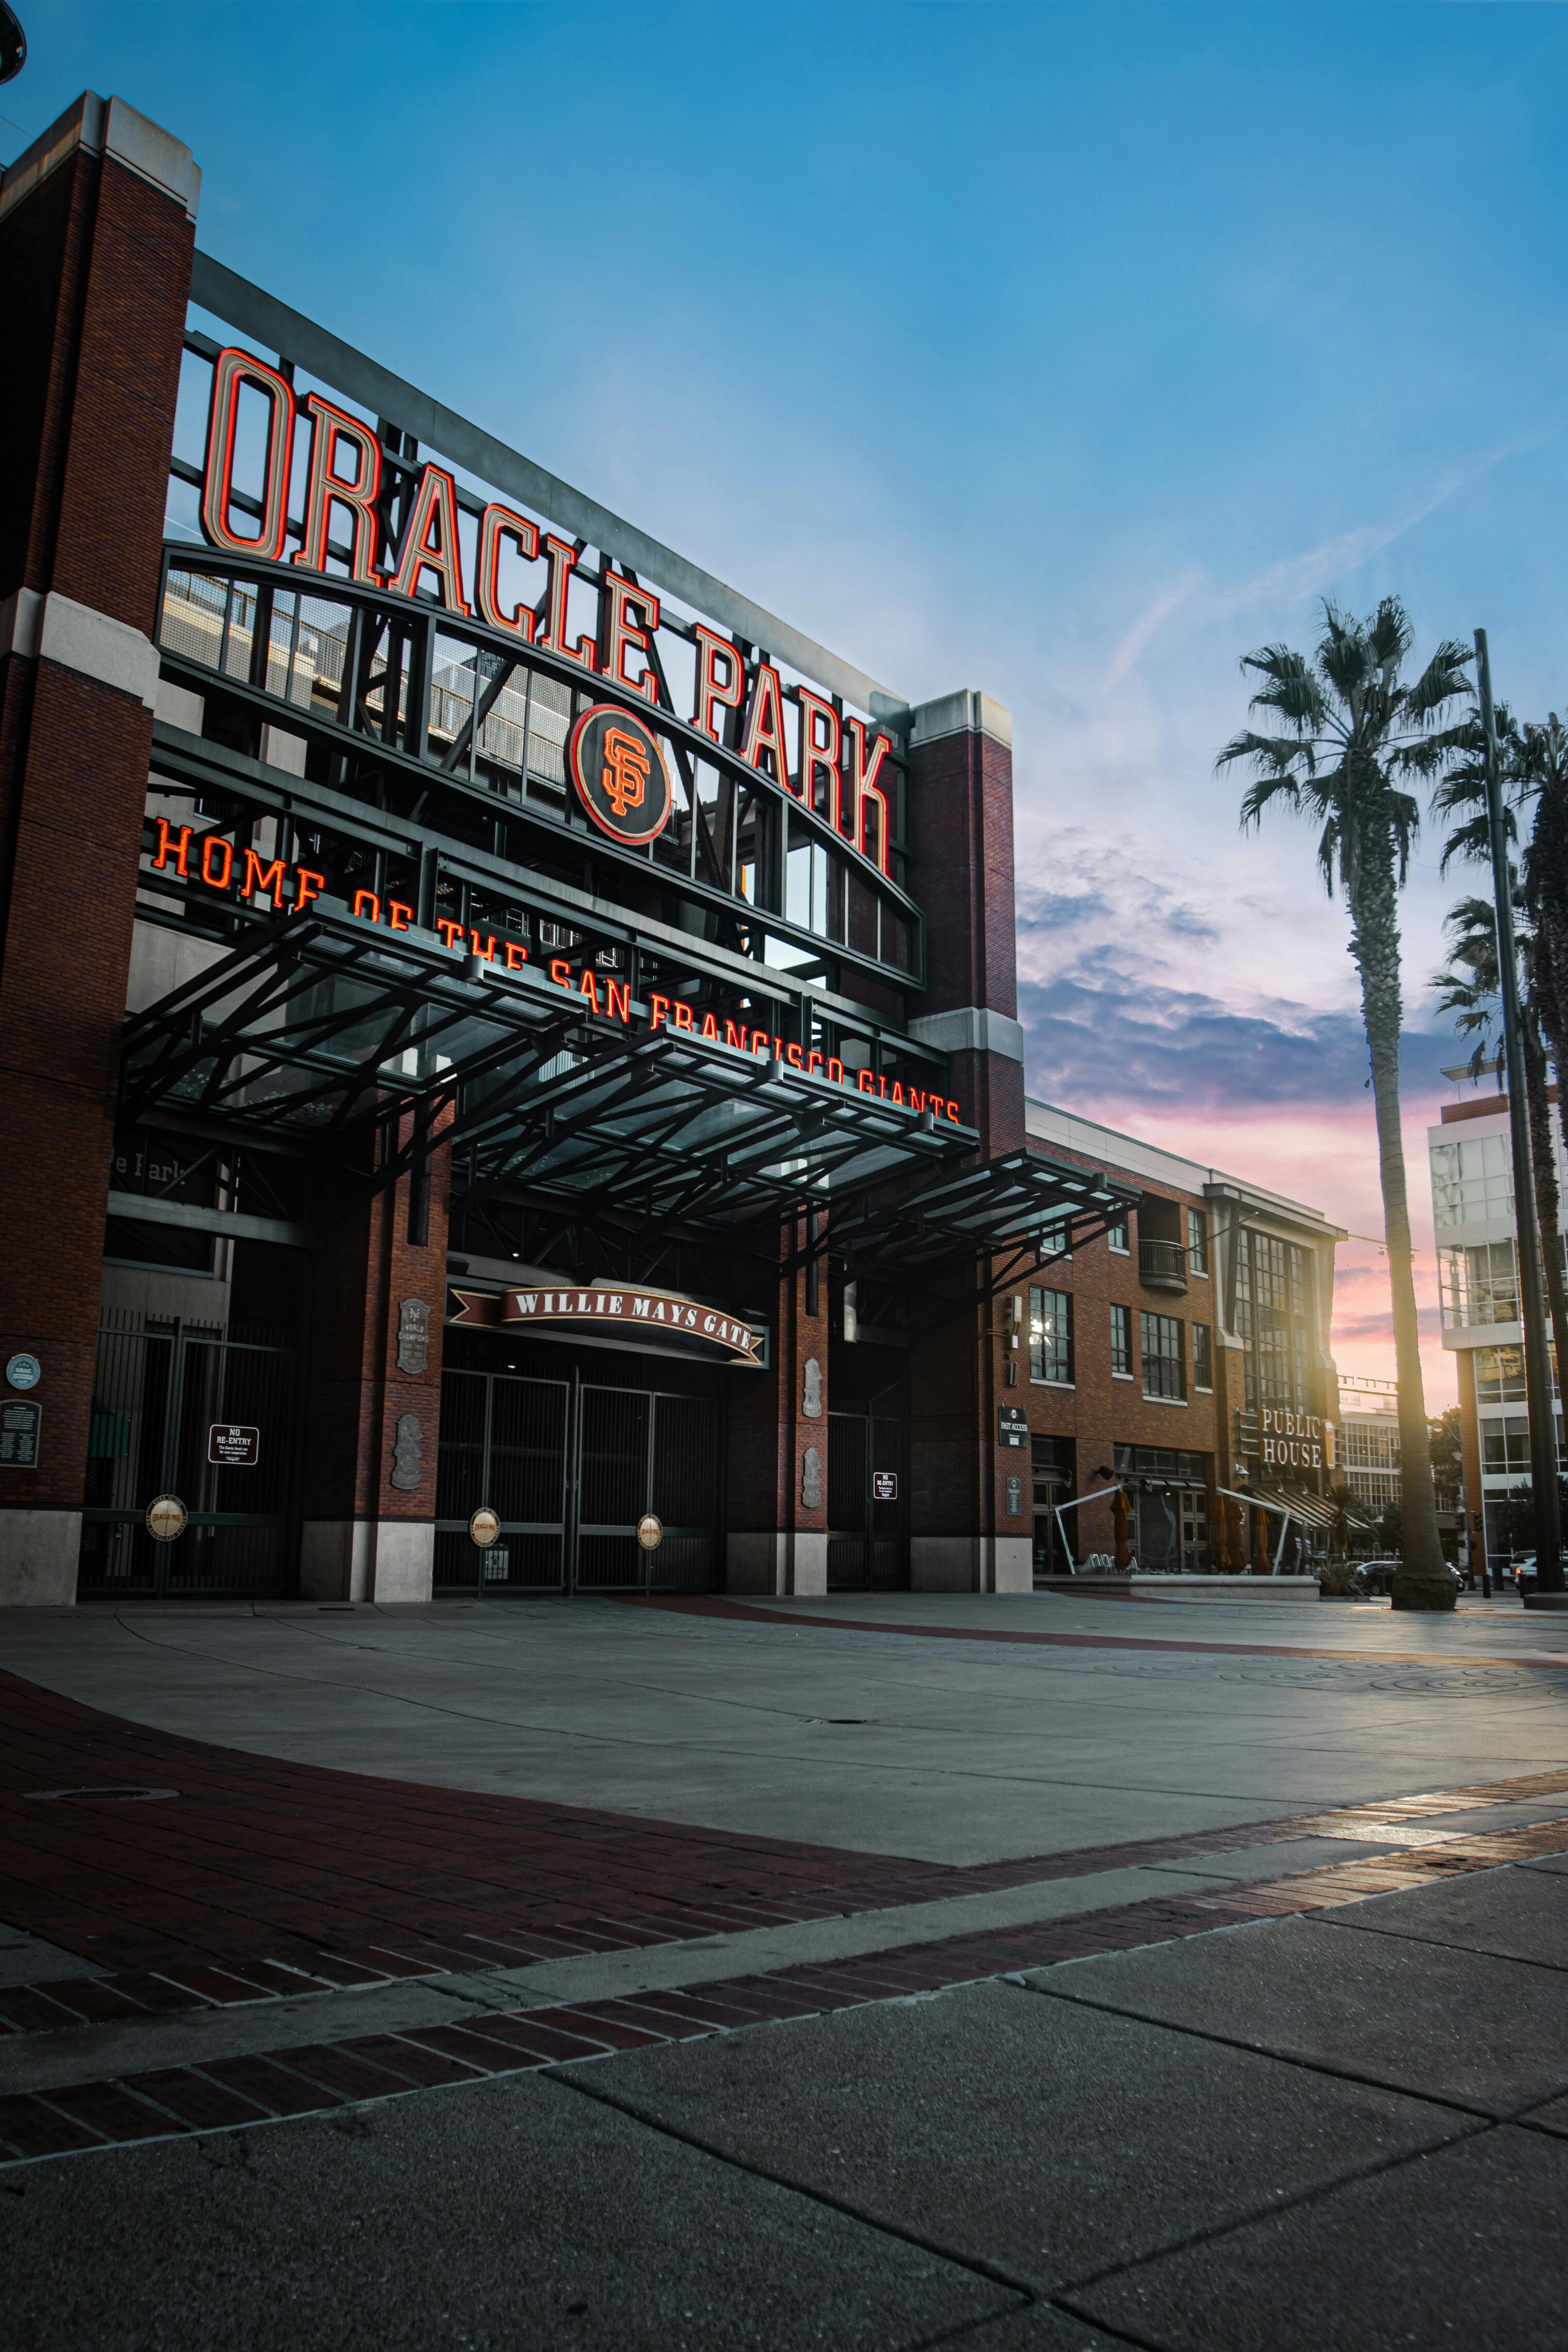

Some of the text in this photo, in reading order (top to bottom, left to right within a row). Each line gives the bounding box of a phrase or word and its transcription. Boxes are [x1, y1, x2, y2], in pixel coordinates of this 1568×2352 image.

[200, 347, 892, 880] ORACLE PARK
[152, 818, 325, 911] HOME
[353, 889, 413, 932] OF
[437, 917, 528, 970] THE
[550, 958, 631, 1023] SAN
[857, 1068, 959, 1124] GIANTS
[404, 1324, 424, 1333] WORLD
[516, 1293, 750, 1349] WILLIE MAYS GATE
[399, 1332, 429, 1343] CHAMPIONS
[229, 1428, 240, 1436] NO
[1001, 1422, 1027, 1431] FAST ACCESS
[1262, 1408, 1321, 1439] PUBLIC
[217, 1436, 252, 1445] RE-ENTRY
[1263, 1438, 1321, 1468] HOUSE
